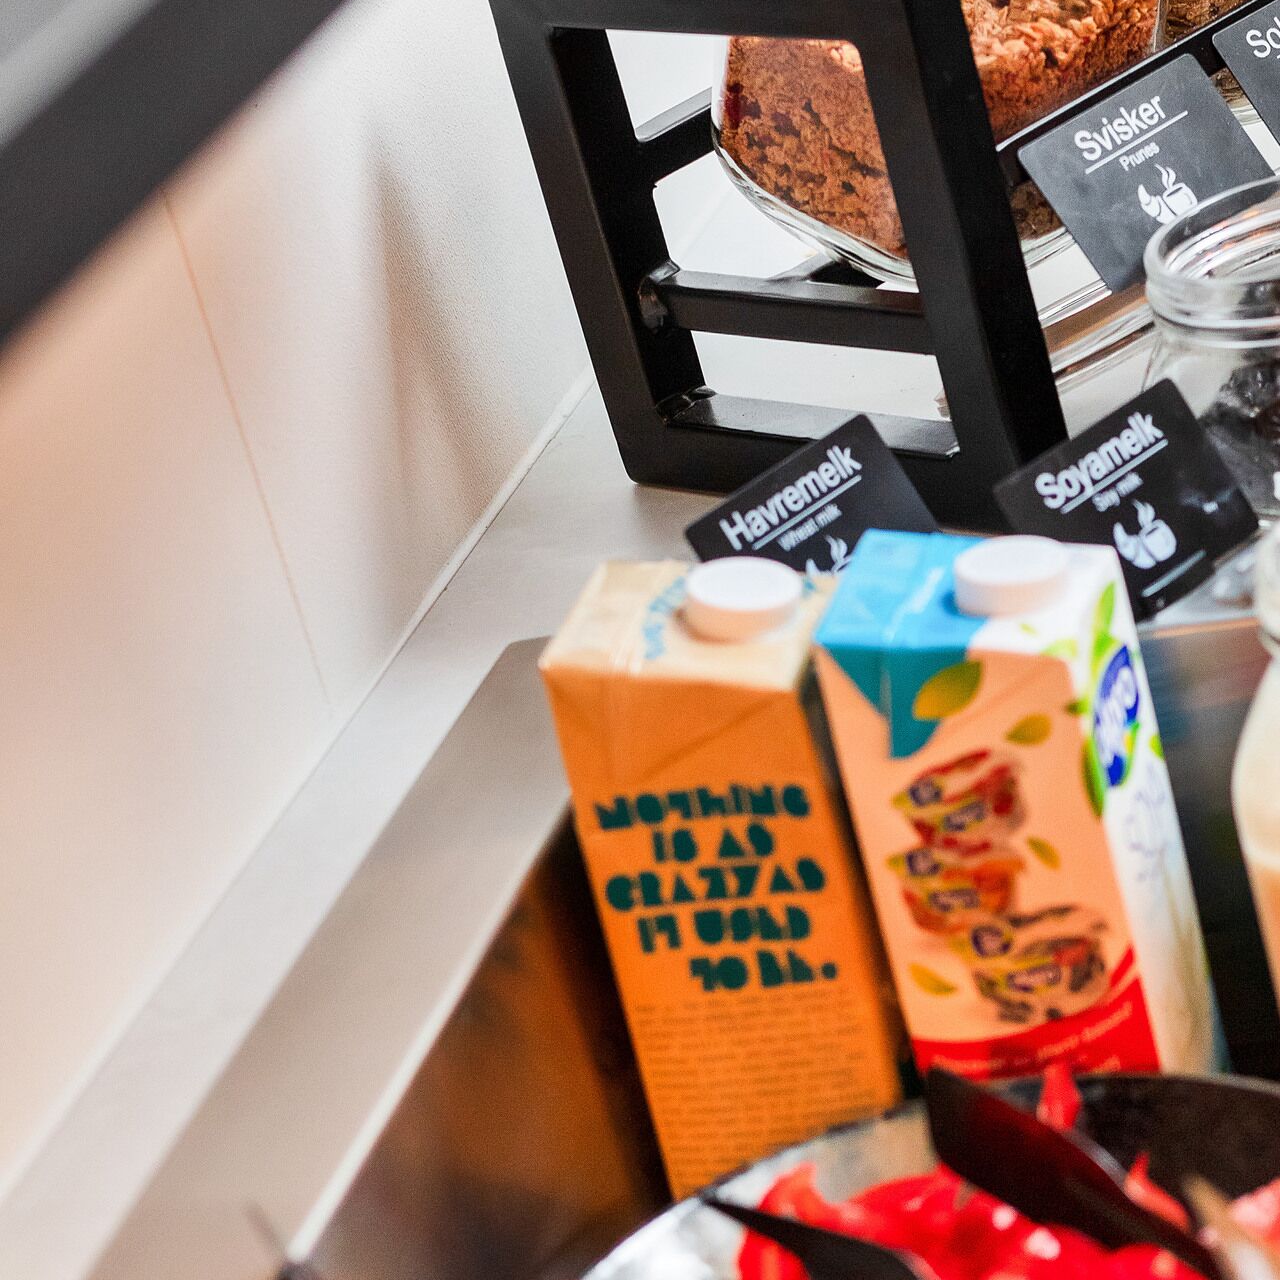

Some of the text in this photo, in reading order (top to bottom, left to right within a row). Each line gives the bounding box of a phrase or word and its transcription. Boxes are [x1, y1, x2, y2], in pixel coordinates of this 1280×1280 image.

[1074, 95, 1167, 161] Svisker
[1119, 141, 1160, 172] Prunes
[719, 445, 863, 552] Havremelk
[1035, 411, 1165, 509] Soyamelk
